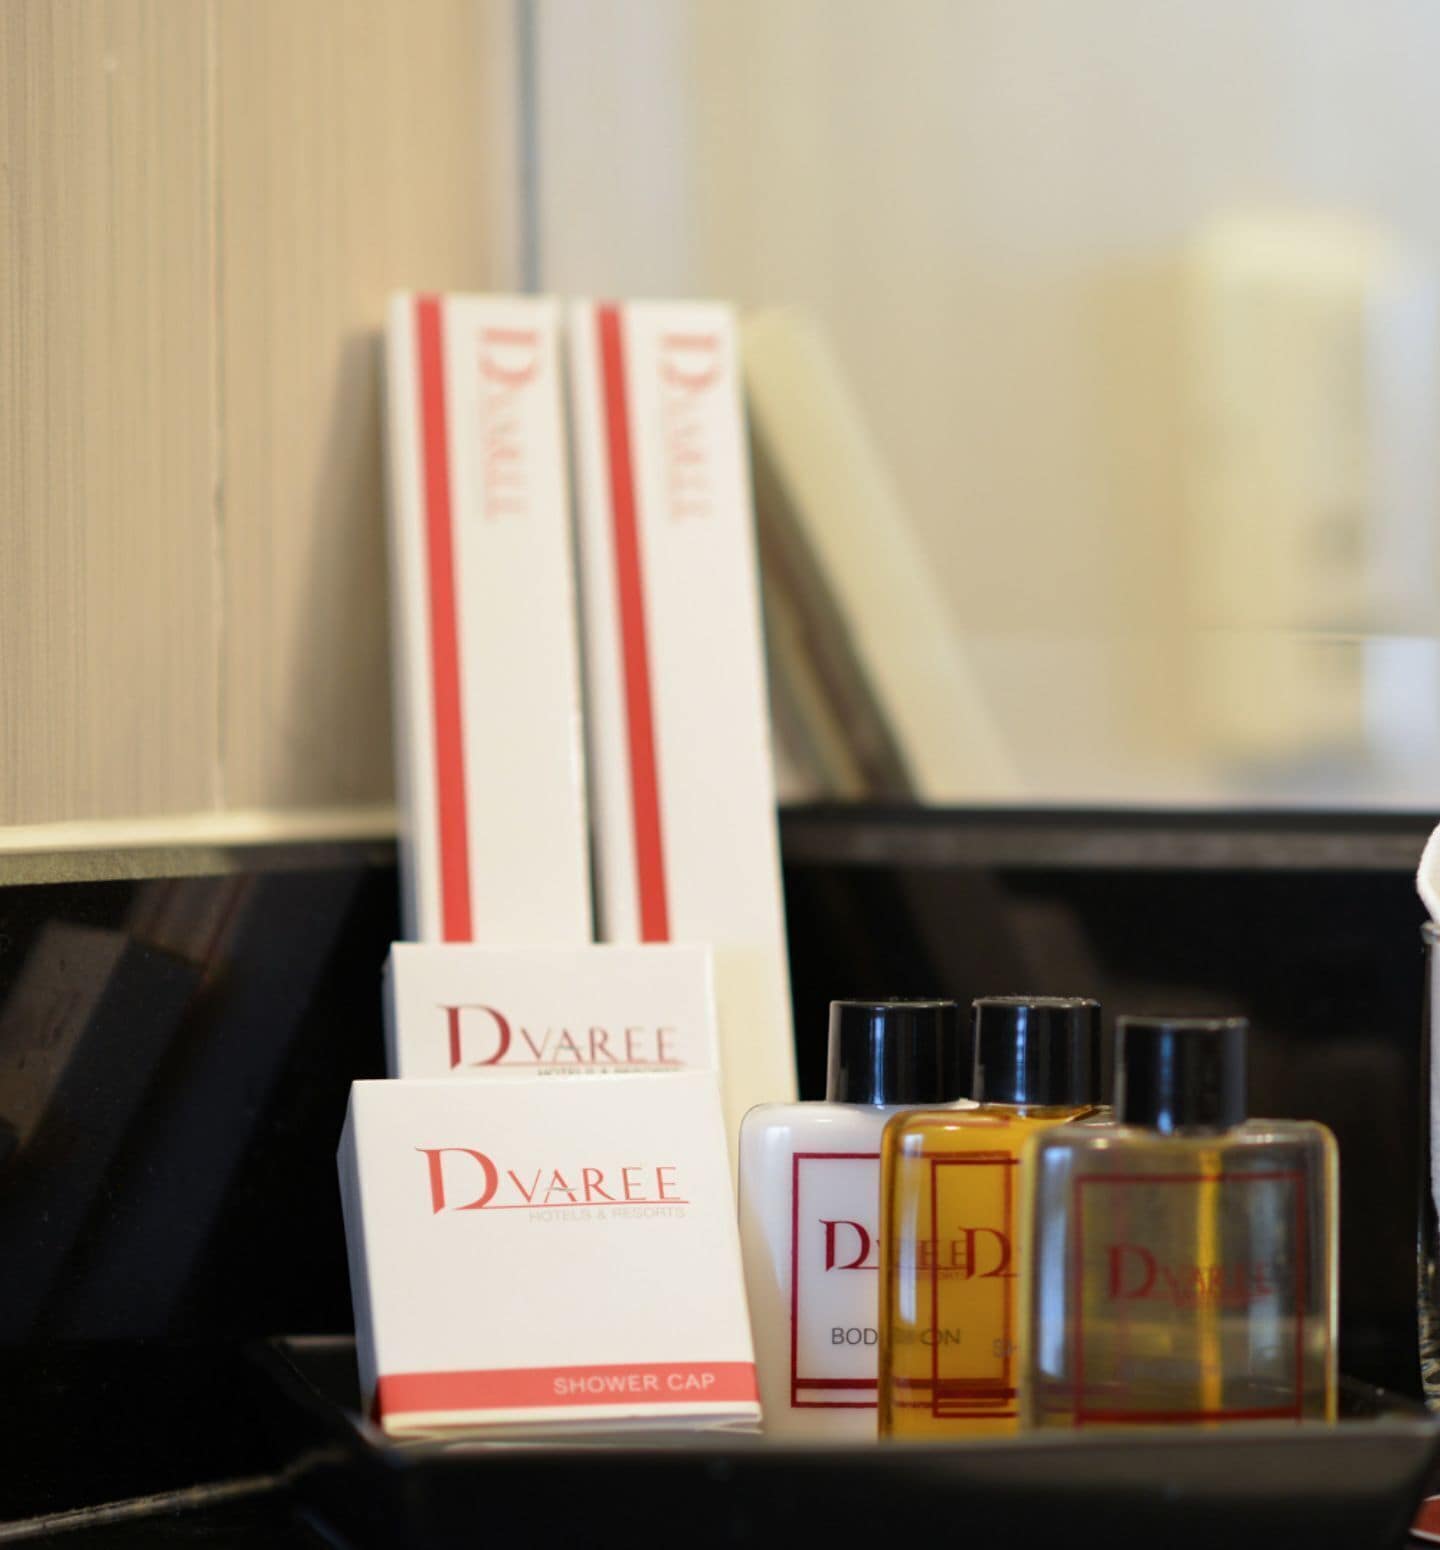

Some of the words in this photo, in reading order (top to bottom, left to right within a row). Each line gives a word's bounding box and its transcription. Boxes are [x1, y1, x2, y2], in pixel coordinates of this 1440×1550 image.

[437, 1003, 684, 1069] DVAREE
[415, 1147, 686, 1214] DVAREE
[553, 1374, 660, 1395] SHOWER
[667, 1372, 716, 1391] CAP
